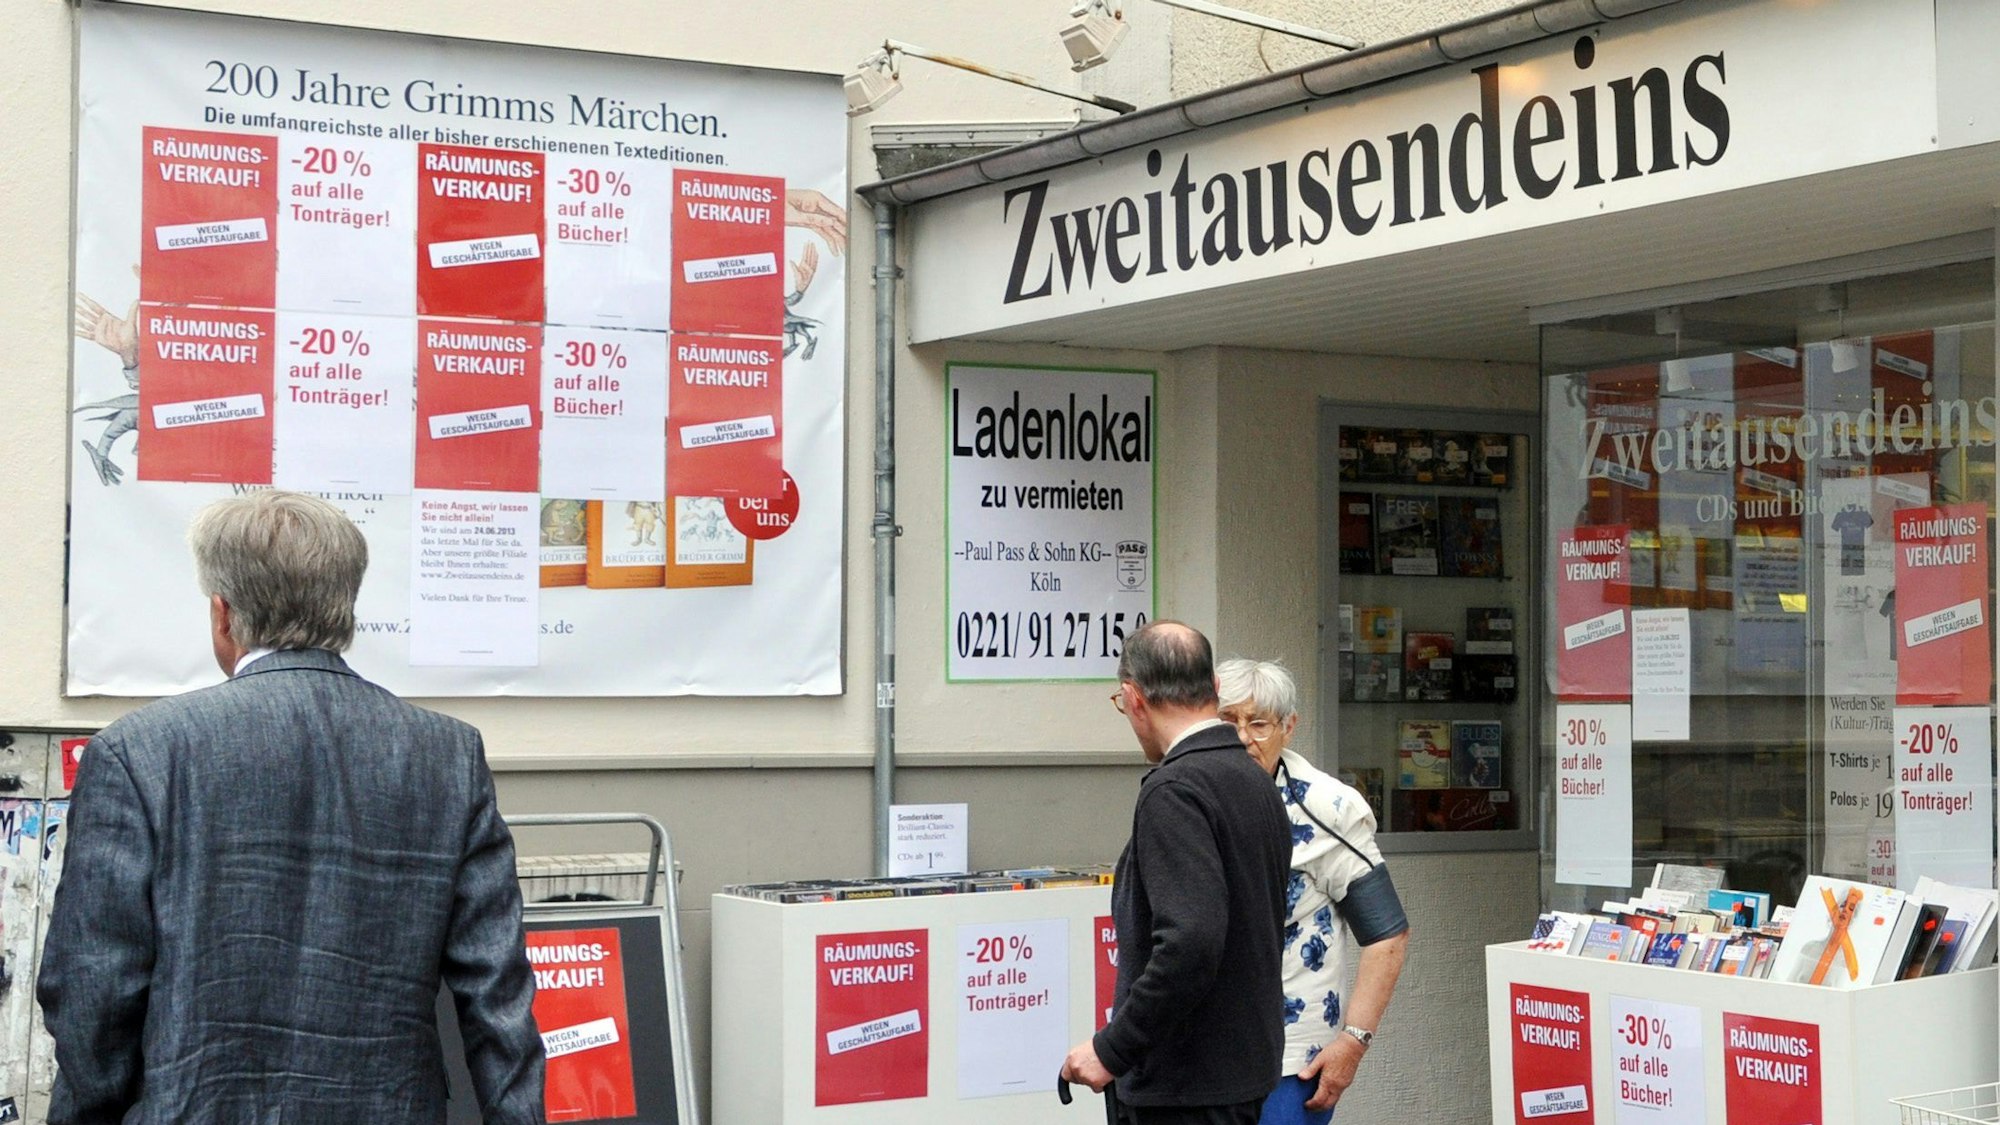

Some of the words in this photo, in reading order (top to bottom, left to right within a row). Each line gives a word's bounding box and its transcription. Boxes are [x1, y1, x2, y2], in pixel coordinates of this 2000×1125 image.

[205, 60, 279, 99] 200
[292, 69, 390, 109] Jahre
[405, 80, 554, 124] Grimms
[568, 94, 728, 138] Märchen.
[204, 106, 236, 125] Die
[242, 112, 383, 138] umfangreichste
[389, 125, 429, 142] aller
[434, 126, 489, 146] bisher
[494, 134, 610, 156] erschienenen
[614, 142, 729, 166] Texteditionen.
[153, 137, 268, 164] RÄUMUNGS-
[292, 147, 337, 174] -20
[344, 151, 371, 177] %
[425, 153, 539, 178] RÄUMUNGS-
[1004, 35, 1731, 304] Zweitausendeins
[160, 163, 260, 187] VERKAUF!
[557, 169, 599, 195] -30
[605, 171, 631, 197] %
[292, 182, 322, 199] auf
[328, 183, 363, 200] alle
[432, 177, 532, 202] VERKAUF!
[680, 179, 777, 204] RÄUMUNGS-
[291, 204, 390, 229] Tonträger!
[558, 200, 585, 218] auf
[591, 202, 624, 220] alle
[686, 202, 770, 225] VERKAUF!
[168, 229, 261, 247] GESCHÄFTSAUFGABE
[197, 224, 230, 234] WEGEN
[558, 223, 628, 244] Bücher!
[441, 247, 534, 265] GESCHÄFTSAUFGABE
[469, 241, 502, 252] WEGEN
[694, 264, 771, 281] GESCHÄFTSAUFGABE
[717, 258, 745, 269] WEGEN
[150, 317, 266, 341] RÄUMUNGS-
[290, 328, 335, 355] -20
[342, 330, 370, 356] %
[427, 331, 532, 354] RÄUMUNGS-
[157, 342, 257, 364] VERKAUF!
[554, 341, 596, 368] -30
[602, 343, 627, 369] %
[677, 345, 774, 366] RÄUMUNGS-
[289, 363, 319, 379] auf
[326, 364, 362, 380] alle
[433, 353, 525, 377] VERKAUF!
[554, 374, 581, 391] auf
[587, 376, 620, 392] alle
[684, 366, 768, 387] VERKAUF!
[194, 401, 227, 412] WEGEN
[289, 386, 388, 409] Tonträger!
[553, 397, 623, 416] Bücher!
[166, 407, 259, 425] GESCHÄFTSAUFGABE
[440, 417, 525, 436] GESCHÄFTSAUFGABE
[466, 411, 497, 423] WEGEN
[953, 388, 1150, 462] Ladenlokal
[691, 427, 770, 446] GESCHÄFTSAUFGABE
[715, 422, 743, 433] WEGEN
[1579, 380, 1996, 479] Zweitausendeins
[981, 484, 1006, 508] zu
[1014, 480, 1123, 510] vermieten
[421, 512, 436, 521] Sie
[439, 513, 462, 522] nicht
[465, 514, 494, 522] allein!
[422, 502, 448, 510] Keine
[451, 502, 478, 512] Angst,
[482, 502, 496, 511] wir
[500, 503, 528, 512] lassen
[1386, 500, 1429, 515] FREY
[1696, 493, 1738, 523] CDs
[1744, 490, 1782, 519] und
[421, 526, 436, 534] Wir
[440, 526, 457, 534] sind
[474, 527, 515, 535] 24.06.2013
[1900, 517, 1981, 540] RÄUMUNGS-
[421, 537, 435, 545] das
[438, 537, 460, 545] letzte
[463, 538, 479, 546] Mal
[482, 538, 493, 546] für
[997, 541, 1024, 561] Pass
[1028, 542, 1039, 561] &
[1044, 542, 1075, 562] Sohn
[1118, 543, 1147, 555] PASS
[1562, 538, 1625, 558] RÄUMUNGS-
[421, 548, 442, 557] Aber
[473, 550, 499, 559] größte
[502, 550, 527, 558] Filiale
[678, 553, 713, 561] BRÜDER
[715, 553, 744, 561] GRIMM
[1906, 543, 1976, 567] VERKAUF!
[1030, 571, 1061, 592] Köln
[1566, 562, 1621, 581] VERKAUF!
[1586, 620, 1605, 631] WEGEN
[1932, 610, 1956, 625] WEGEN
[957, 611, 1022, 658] 0221/
[1028, 611, 1055, 658] 91
[1063, 612, 1091, 658] 27
[1913, 615, 1979, 642] GESCHÄFTSAUFGABE
[1830, 697, 1867, 710] Werden
[1870, 697, 1885, 710] Sie
[1562, 719, 1587, 746] -30
[1590, 719, 1606, 746] %
[1901, 724, 1933, 754] -20
[1937, 724, 1958, 754] %
[1562, 753, 1578, 770] auf
[1581, 753, 1602, 770] alle
[1830, 753, 1868, 768] T-Shirts
[1871, 755, 1880, 771] je
[1901, 763, 1923, 782] auf
[1927, 763, 1953, 781] alle
[1562, 777, 1605, 796] Bücher!
[1830, 791, 1857, 806] Polos
[1860, 794, 1869, 809] je
[1901, 791, 1972, 815] Tonträger!
[824, 941, 920, 963] RÄUMUNGS-
[966, 937, 1004, 963] -20
[1009, 934, 1033, 961] %
[830, 964, 914, 987] VERKAUF!
[967, 970, 991, 987] auf
[997, 968, 1027, 985] alle
[967, 990, 1049, 1012] Tonträger!
[1515, 995, 1585, 1023] RÄUMUNGS-
[546, 1030, 579, 1043] WEGEN
[837, 1022, 915, 1051] GESCHÄFTSAUFGABE
[861, 1020, 889, 1035] WEGEN
[1520, 1022, 1580, 1051] VERKAUF!
[1617, 1012, 1648, 1046] -30
[1652, 1017, 1671, 1050] %
[1729, 1026, 1813, 1056] RÄUMUNGS-
[1619, 1053, 1640, 1075] auf
[1644, 1056, 1668, 1078] alle
[1735, 1055, 1808, 1087] VERKAUF!
[1545, 1090, 1565, 1103] WEGEN
[1620, 1079, 1673, 1108] Bücher!
[1529, 1098, 1585, 1115] GESCHÄFTSAUFGABE
